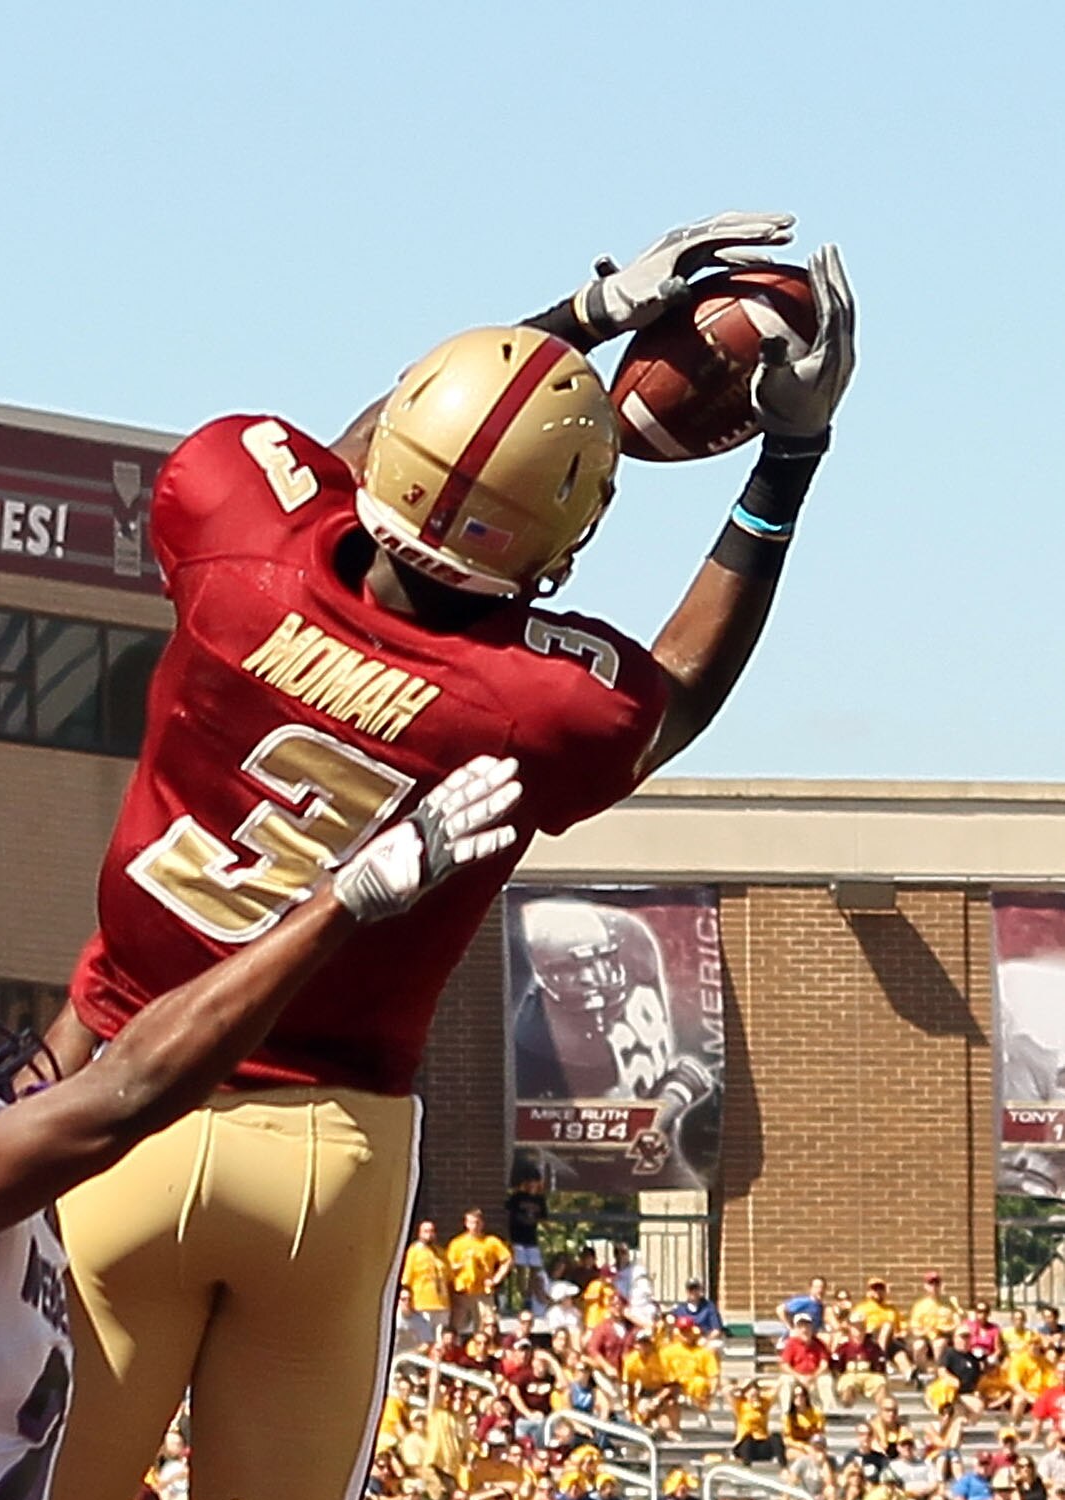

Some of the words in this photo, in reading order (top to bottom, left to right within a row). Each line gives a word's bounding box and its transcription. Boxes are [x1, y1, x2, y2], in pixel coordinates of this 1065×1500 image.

[240, 418, 321, 513] 3
[402, 483, 426, 506] 3
[373, 526, 471, 585] EAGLES
[241, 612, 441, 742] MOMAH
[525, 616, 620, 689] 3
[126, 723, 417, 943] 3
[530, 1109, 575, 1120] MIKE
[580, 1109, 629, 1120] RUTH
[551, 1122, 627, 1141] 1984
[1008, 1111, 1058, 1123] TONY
